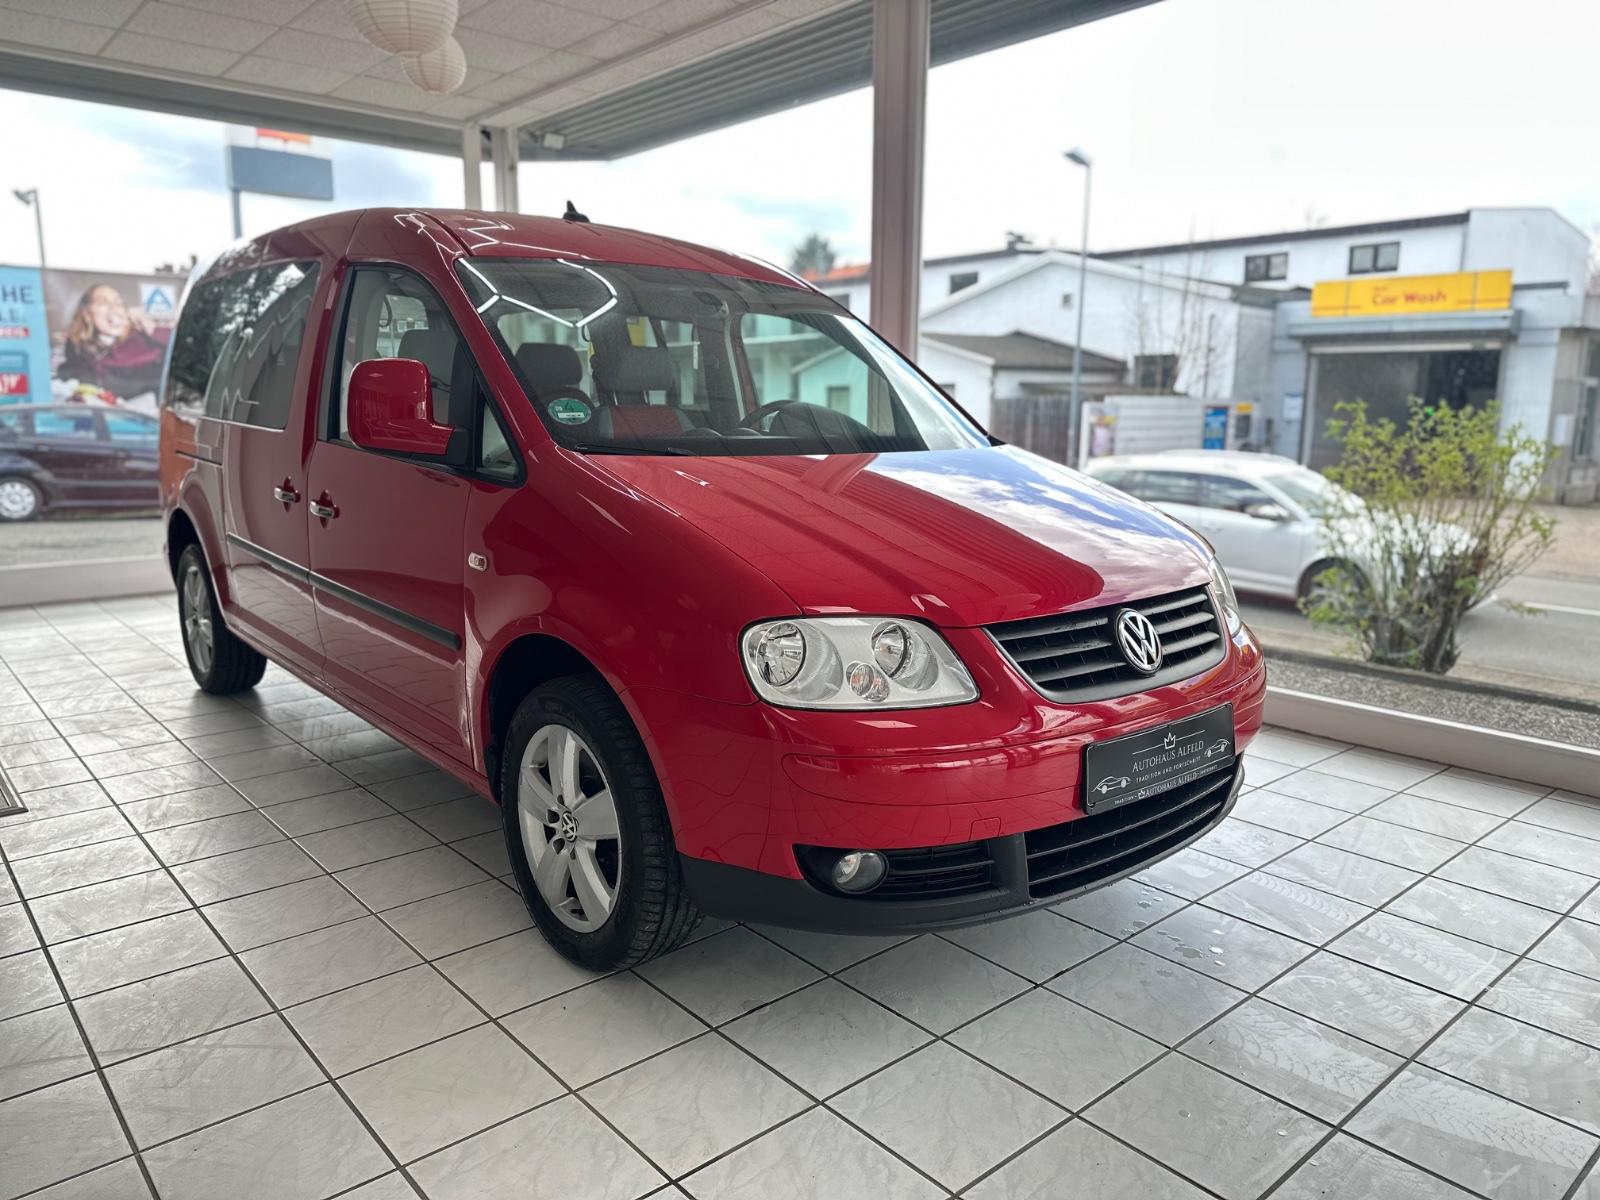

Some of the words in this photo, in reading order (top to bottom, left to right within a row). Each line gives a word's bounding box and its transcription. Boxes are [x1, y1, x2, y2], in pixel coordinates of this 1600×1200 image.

[1404, 289, 1447, 304] Wash
[1132, 750, 1175, 773] AUTOHAUS
[1177, 740, 1204, 758] ALFELD
[1145, 779, 1177, 798] AUTOHAUS
[1177, 771, 1198, 787] ALFELD
